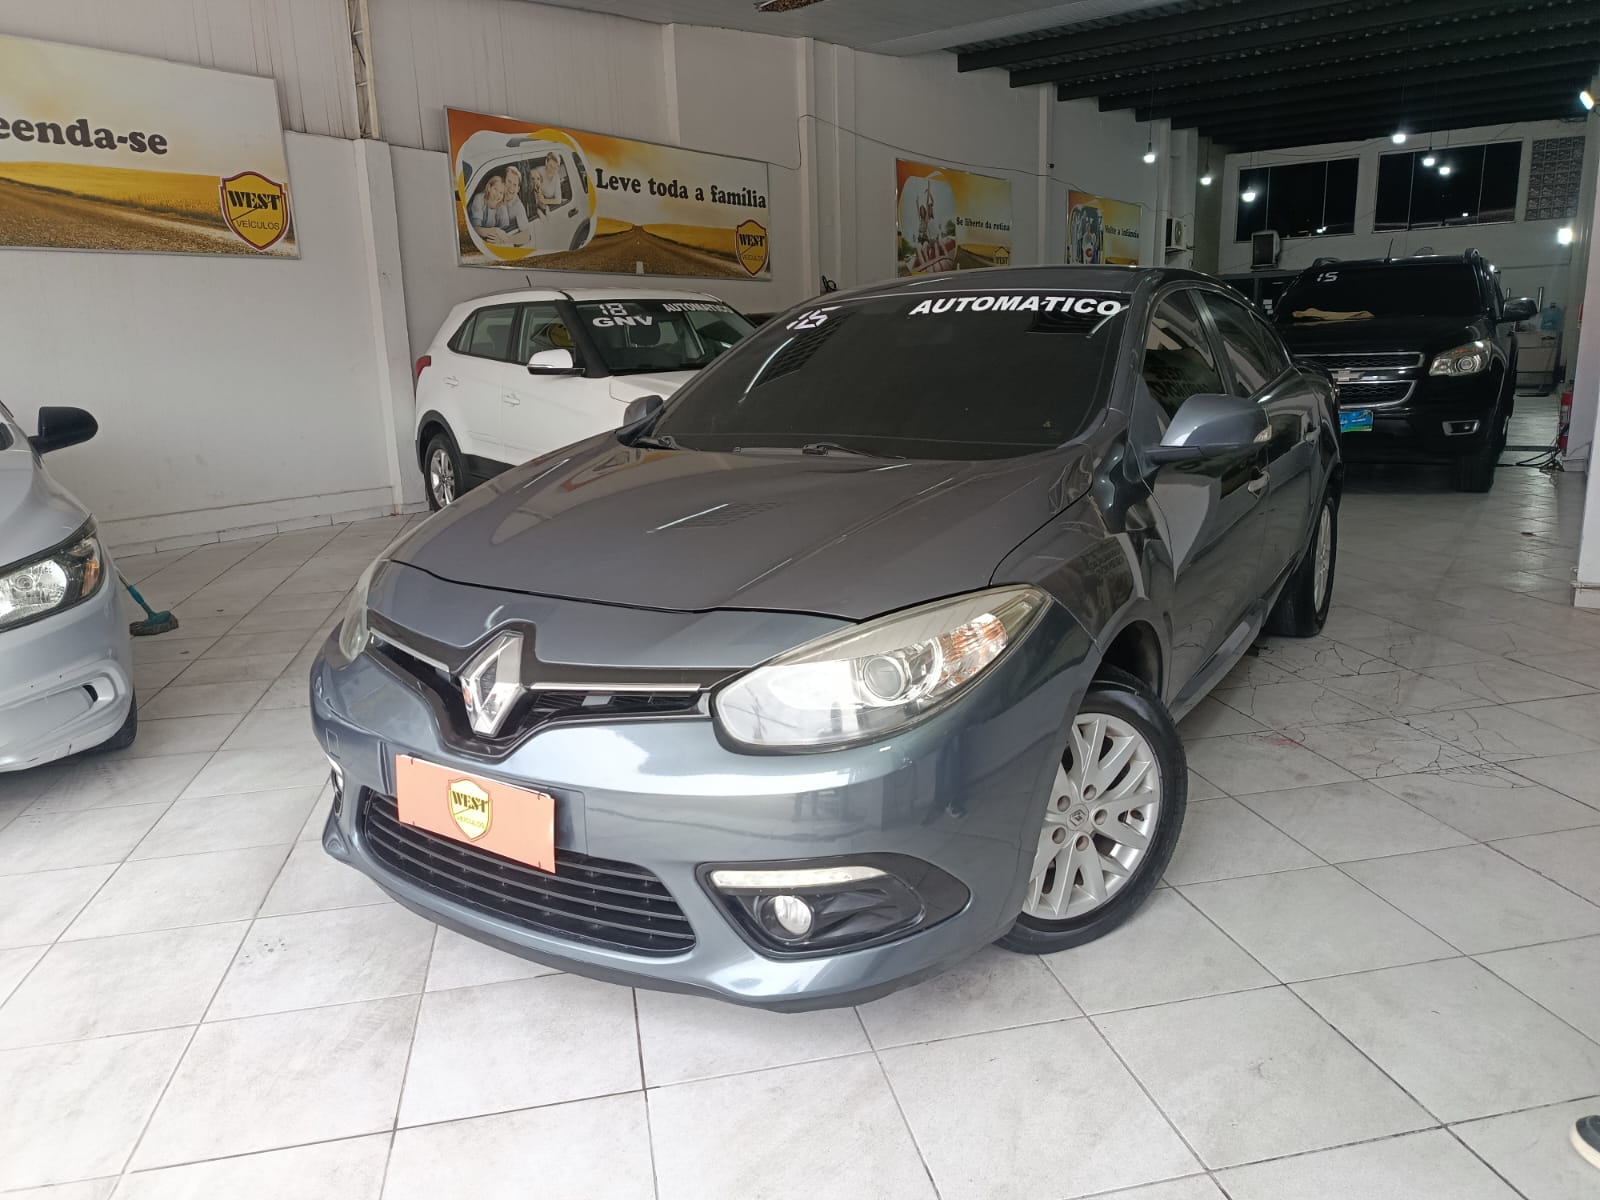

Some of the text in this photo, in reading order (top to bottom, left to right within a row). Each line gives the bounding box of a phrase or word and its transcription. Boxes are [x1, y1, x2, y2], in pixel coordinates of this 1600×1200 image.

[595, 168, 767, 208] Leve toda a família
[228, 190, 281, 211] WEST
[739, 234, 765, 247] WEST
[1317, 271, 1339, 282] 15
[592, 315, 653, 328] GNV
[452, 791, 487, 812] WEST
